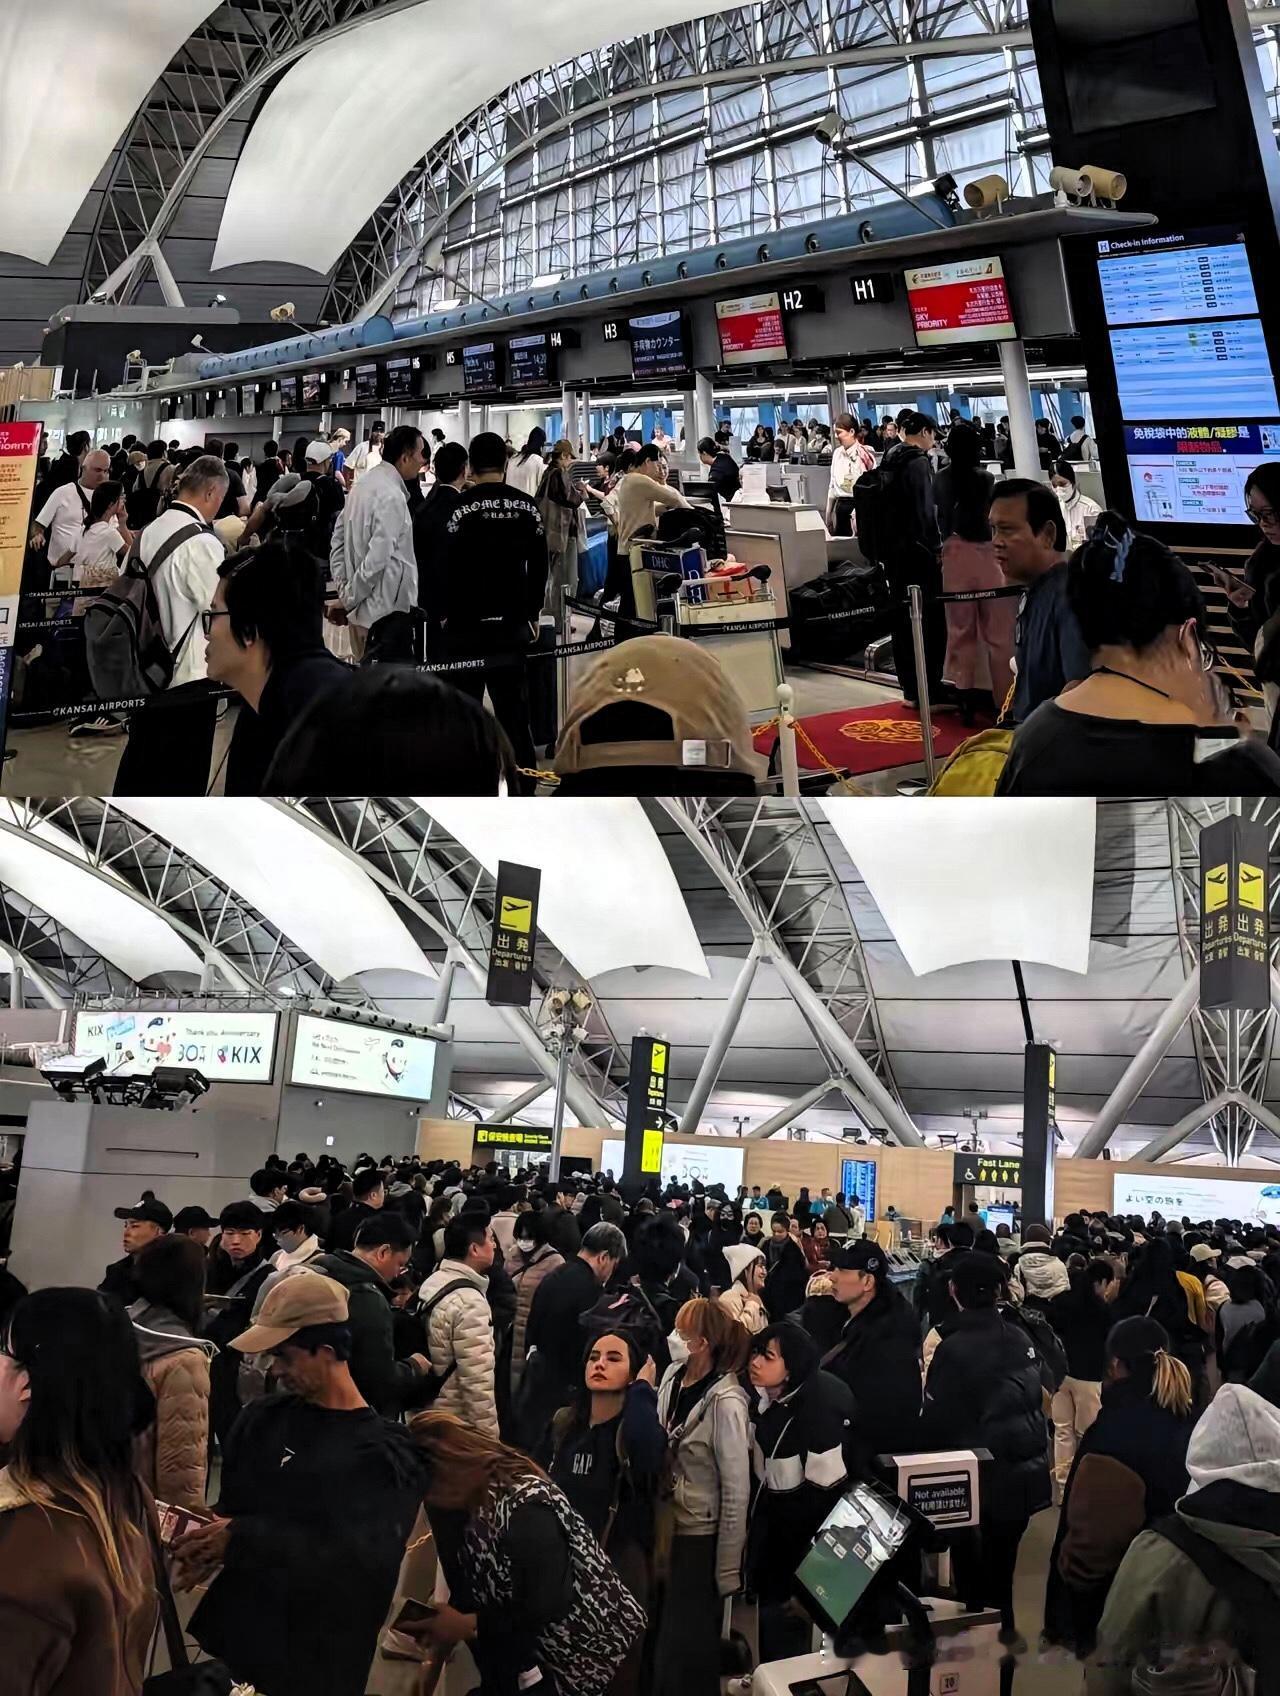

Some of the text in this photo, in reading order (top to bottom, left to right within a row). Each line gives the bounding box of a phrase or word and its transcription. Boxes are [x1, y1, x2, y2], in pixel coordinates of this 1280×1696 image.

[1110, 239, 1141, 250] Check-in
[1142, 234, 1185, 246] Information
[854, 279, 875, 300] H1
[783, 290, 803, 311] H2
[915, 313, 929, 322] SKY
[916, 319, 948, 329] PRIORITY
[550, 332, 562, 347] H4
[604, 323, 618, 340] H3
[726, 620, 776, 633] KANSAI AIRPORTS
[559, 639, 615, 656] KANSAI AIRPORTS
[420, 659, 485, 673] KANSAI AIRPORTS
[60, 698, 146, 716] KANSAI AIRPORTS
[1205, 914, 1229, 939] 出発
[1238, 913, 1265, 937] 出発
[497, 933, 529, 952] 出発
[1233, 932, 1268, 950] Departures
[491, 947, 532, 962] Departures
[88, 1024, 104, 1037] KIX
[231, 1046, 263, 1065] KIX
[977, 1158, 1020, 1169] Fast Lane
[572, 1453, 593, 1475] GAP
[914, 1487, 965, 1500] Not available
